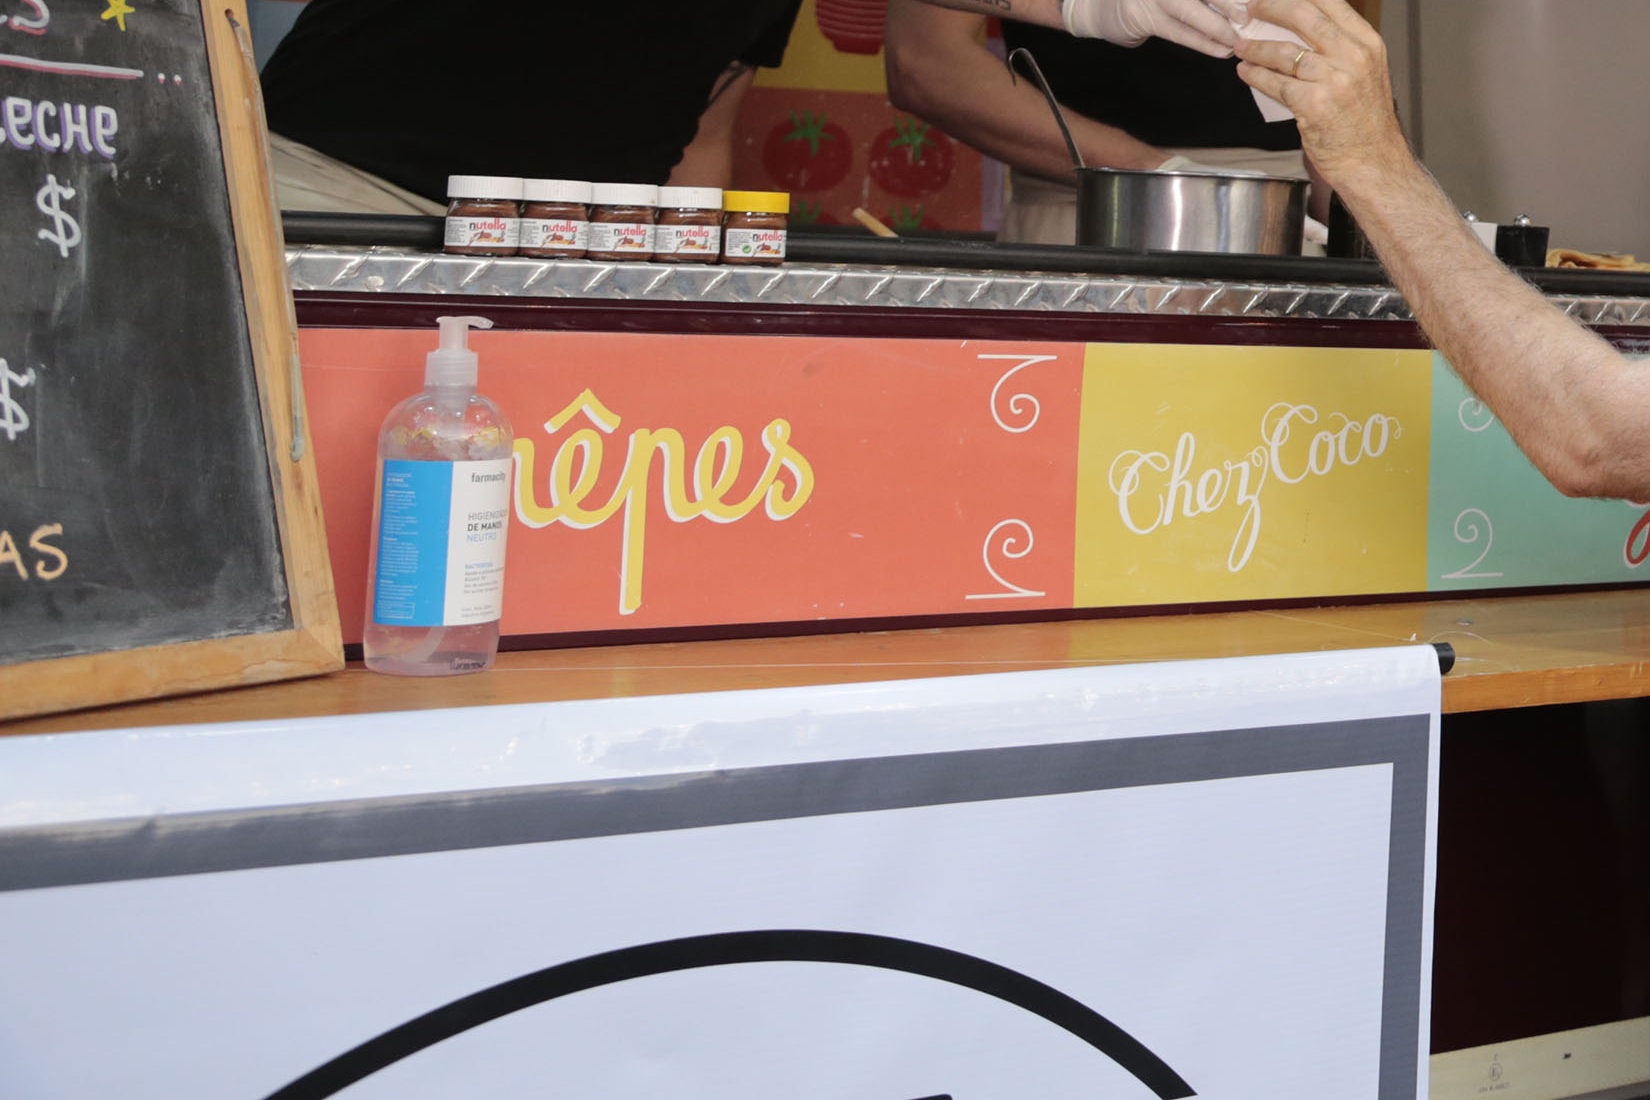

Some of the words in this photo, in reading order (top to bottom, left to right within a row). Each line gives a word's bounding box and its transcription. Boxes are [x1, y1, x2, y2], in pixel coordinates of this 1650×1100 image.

[0, 96, 119, 160] ECHE
[36, 173, 82, 259] $
[469, 217, 507, 231] nutella
[542, 220, 578, 233] nutella
[613, 223, 647, 237] nutella
[675, 226, 710, 238] nutella
[752, 229, 783, 242] nutella
[1108, 431, 1270, 573] Chez
[1260, 401, 1404, 485] Coco
[467, 523, 479, 532] DE
